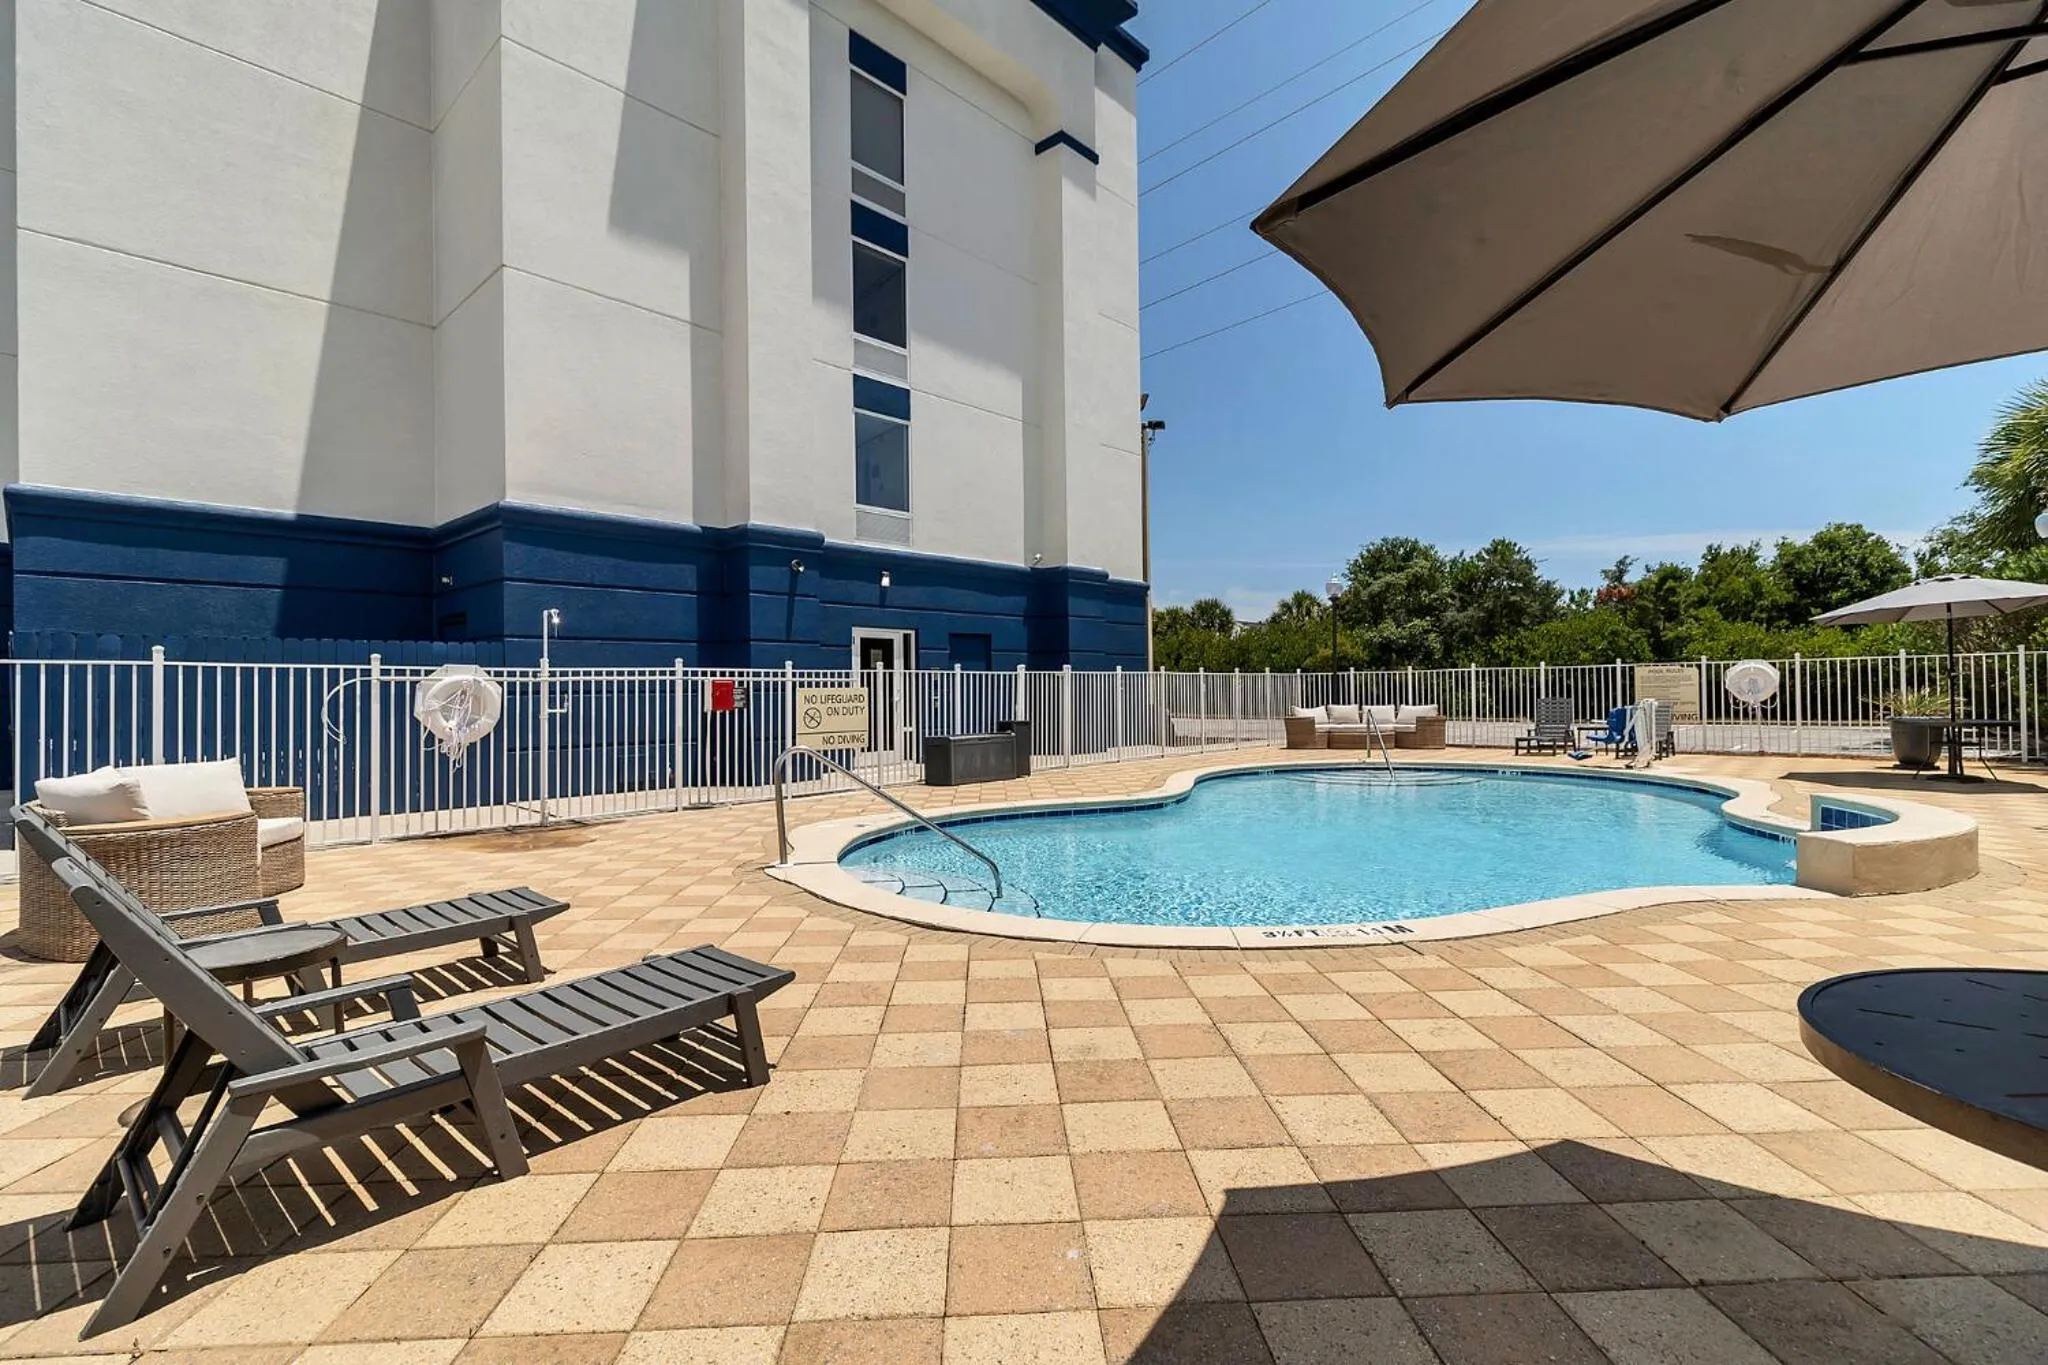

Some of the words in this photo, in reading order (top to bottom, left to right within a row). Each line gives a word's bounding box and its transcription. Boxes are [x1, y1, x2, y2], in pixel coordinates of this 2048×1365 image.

[803, 694, 817, 705] NO
[820, 694, 865, 704] LIFEGUARD
[826, 706, 840, 716] ON
[842, 706, 865, 716] DUTY
[1671, 713, 1698, 721] IVING
[822, 735, 835, 745] NO
[837, 733, 865, 745] DIVING
